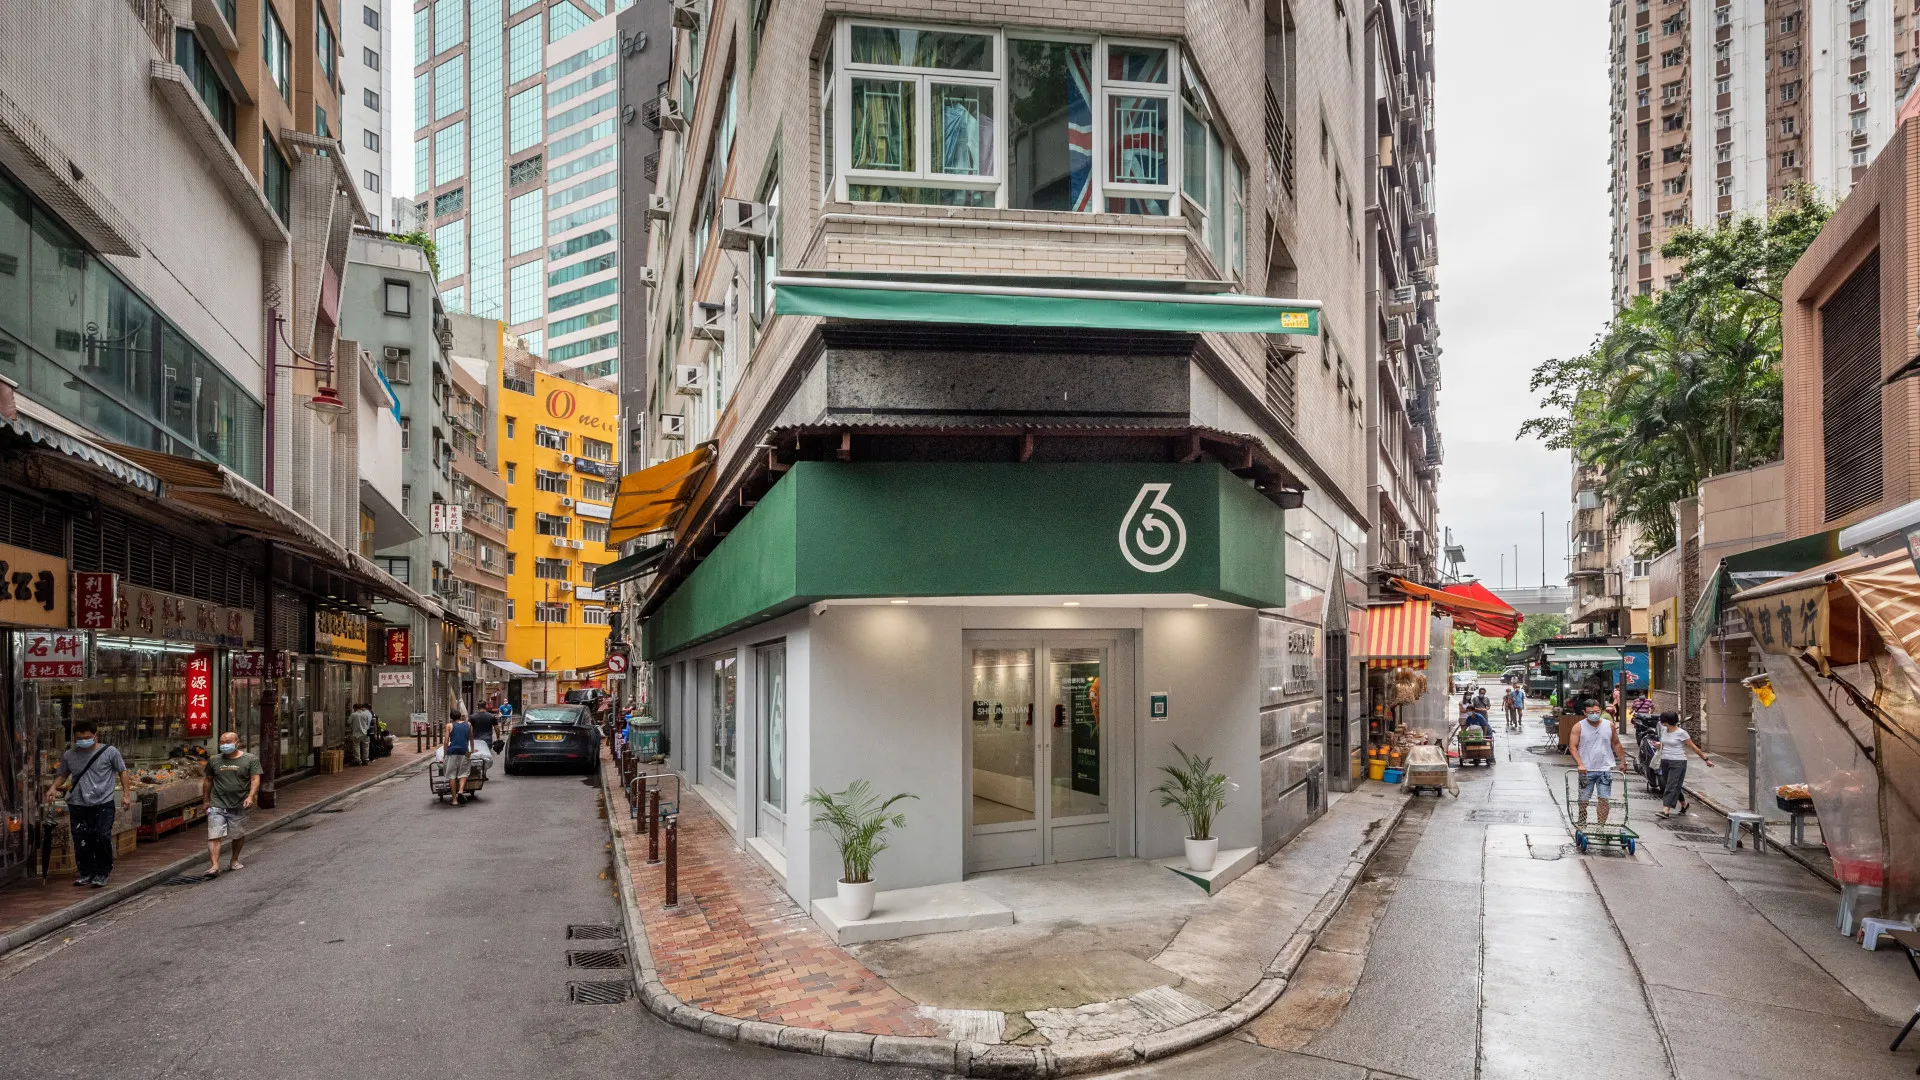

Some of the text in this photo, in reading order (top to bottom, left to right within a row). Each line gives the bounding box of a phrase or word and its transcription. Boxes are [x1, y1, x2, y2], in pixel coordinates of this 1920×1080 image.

[84, 576, 105, 627] 利源行
[27, 634, 81, 658] 石斛
[392, 632, 405, 663] 利豐行
[26, 664, 84, 677] 產地直銷
[190, 657, 208, 708] 利源行
[977, 706, 1030, 715] SHEUNG WAN
